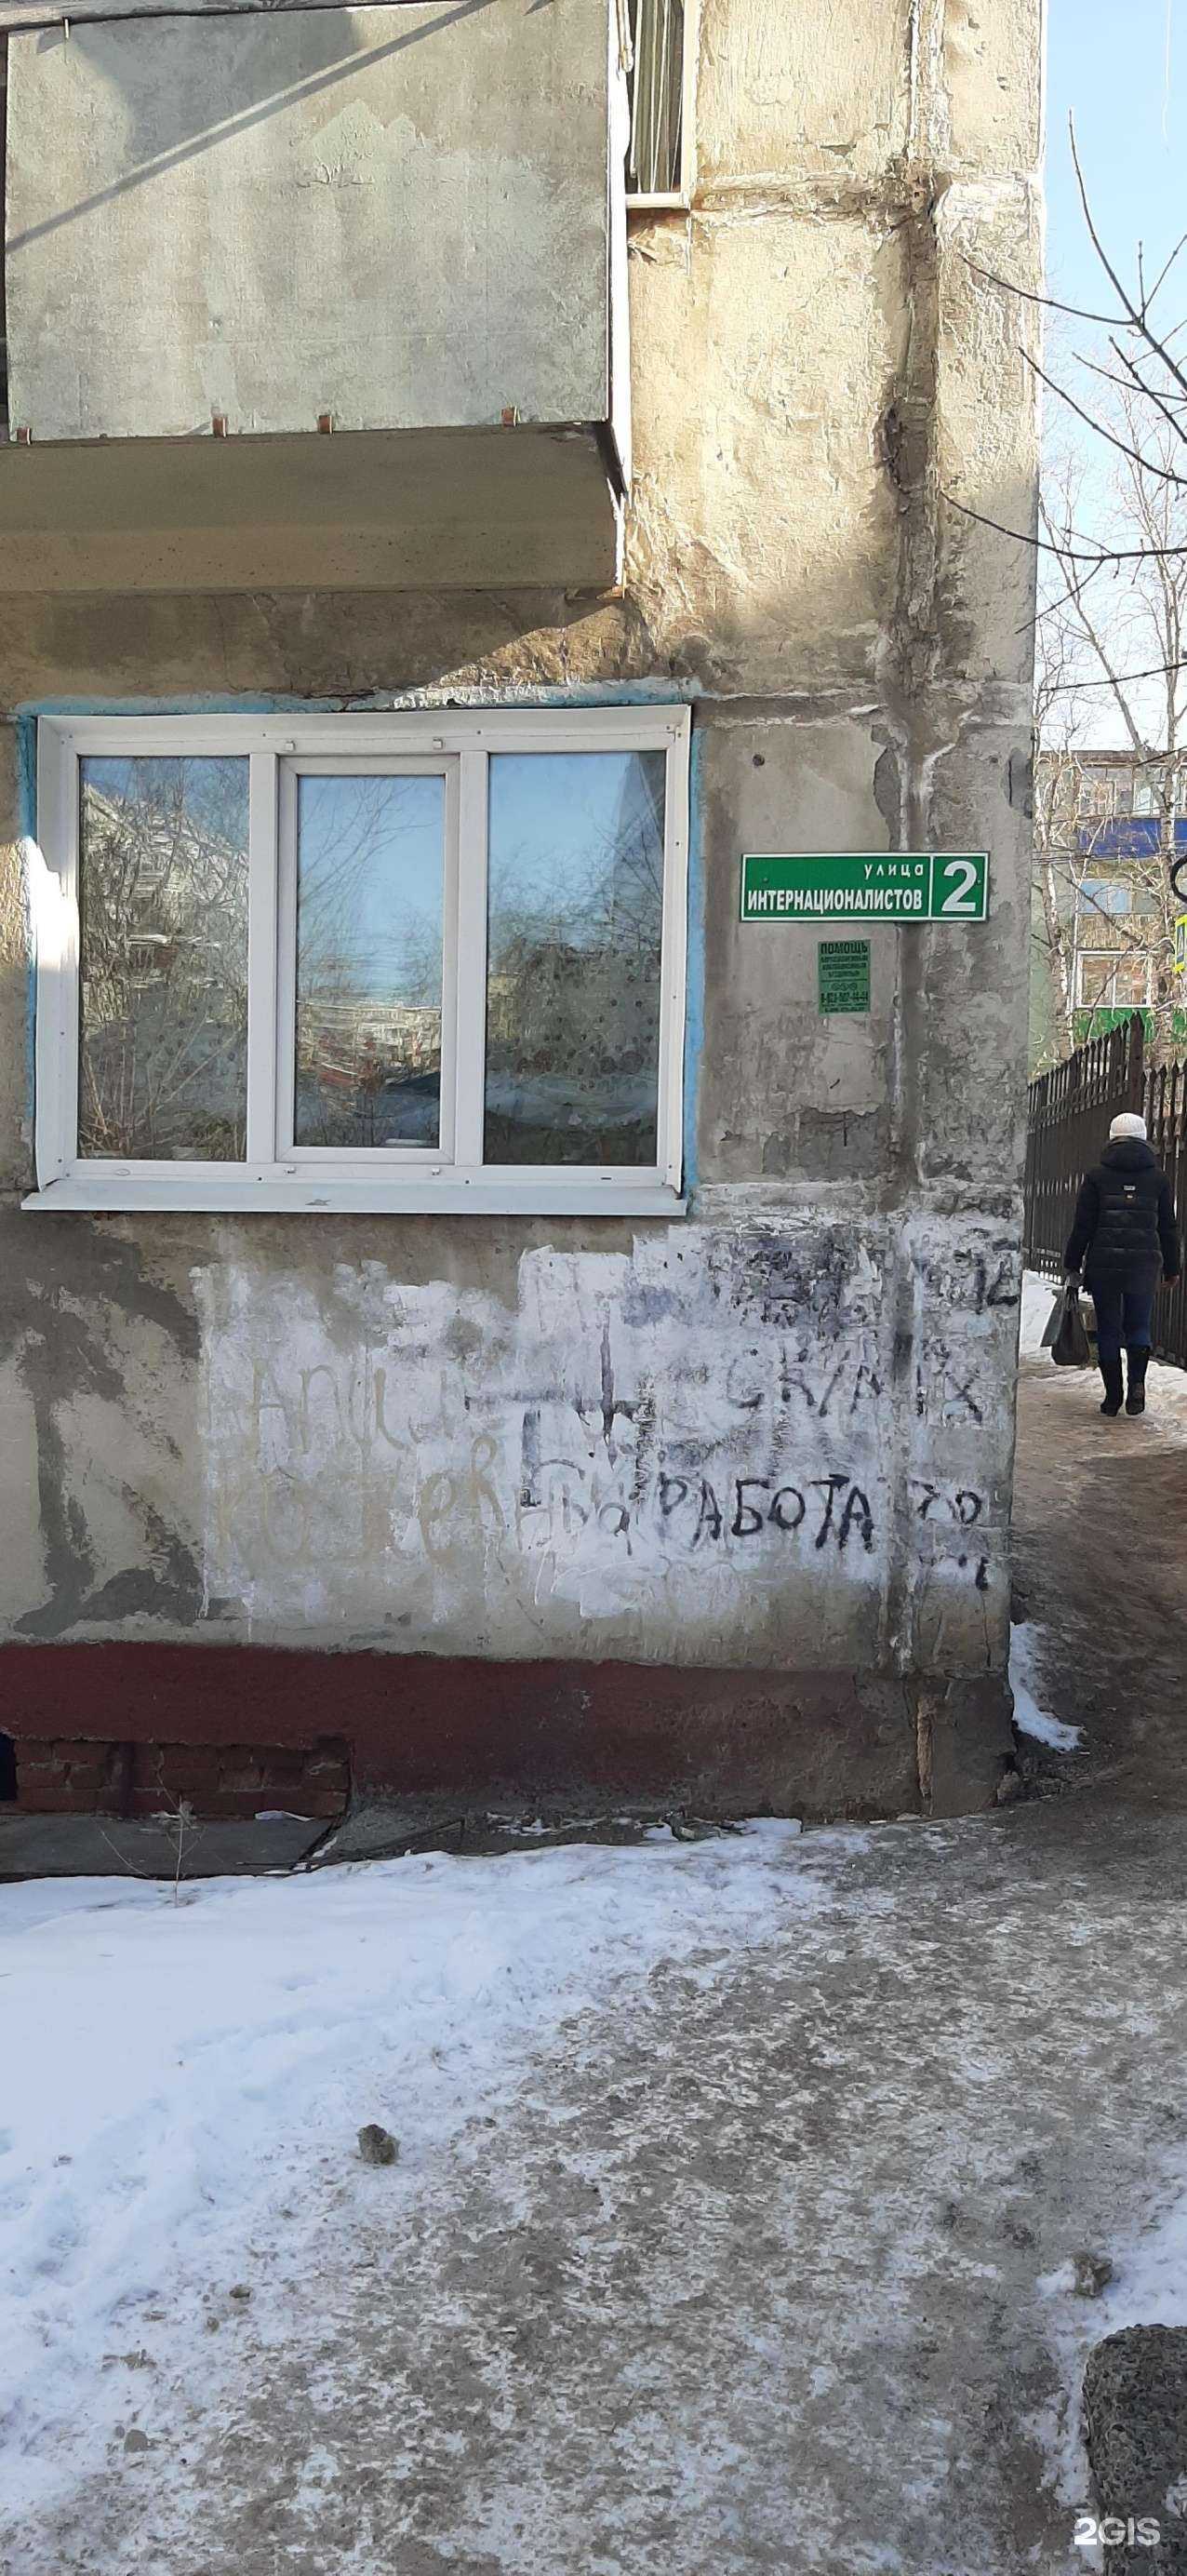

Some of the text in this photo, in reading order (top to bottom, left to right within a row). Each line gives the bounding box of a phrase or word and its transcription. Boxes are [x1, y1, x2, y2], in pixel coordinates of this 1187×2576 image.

[864, 863, 924, 879] улица
[940, 860, 978, 912] 2
[747, 889, 923, 915] ИНТЕРНАЦИОНАЛИСТОВ
[820, 942, 869, 955] ПОМОЩЬ
[660, 1472, 876, 1553] РАБОТА
